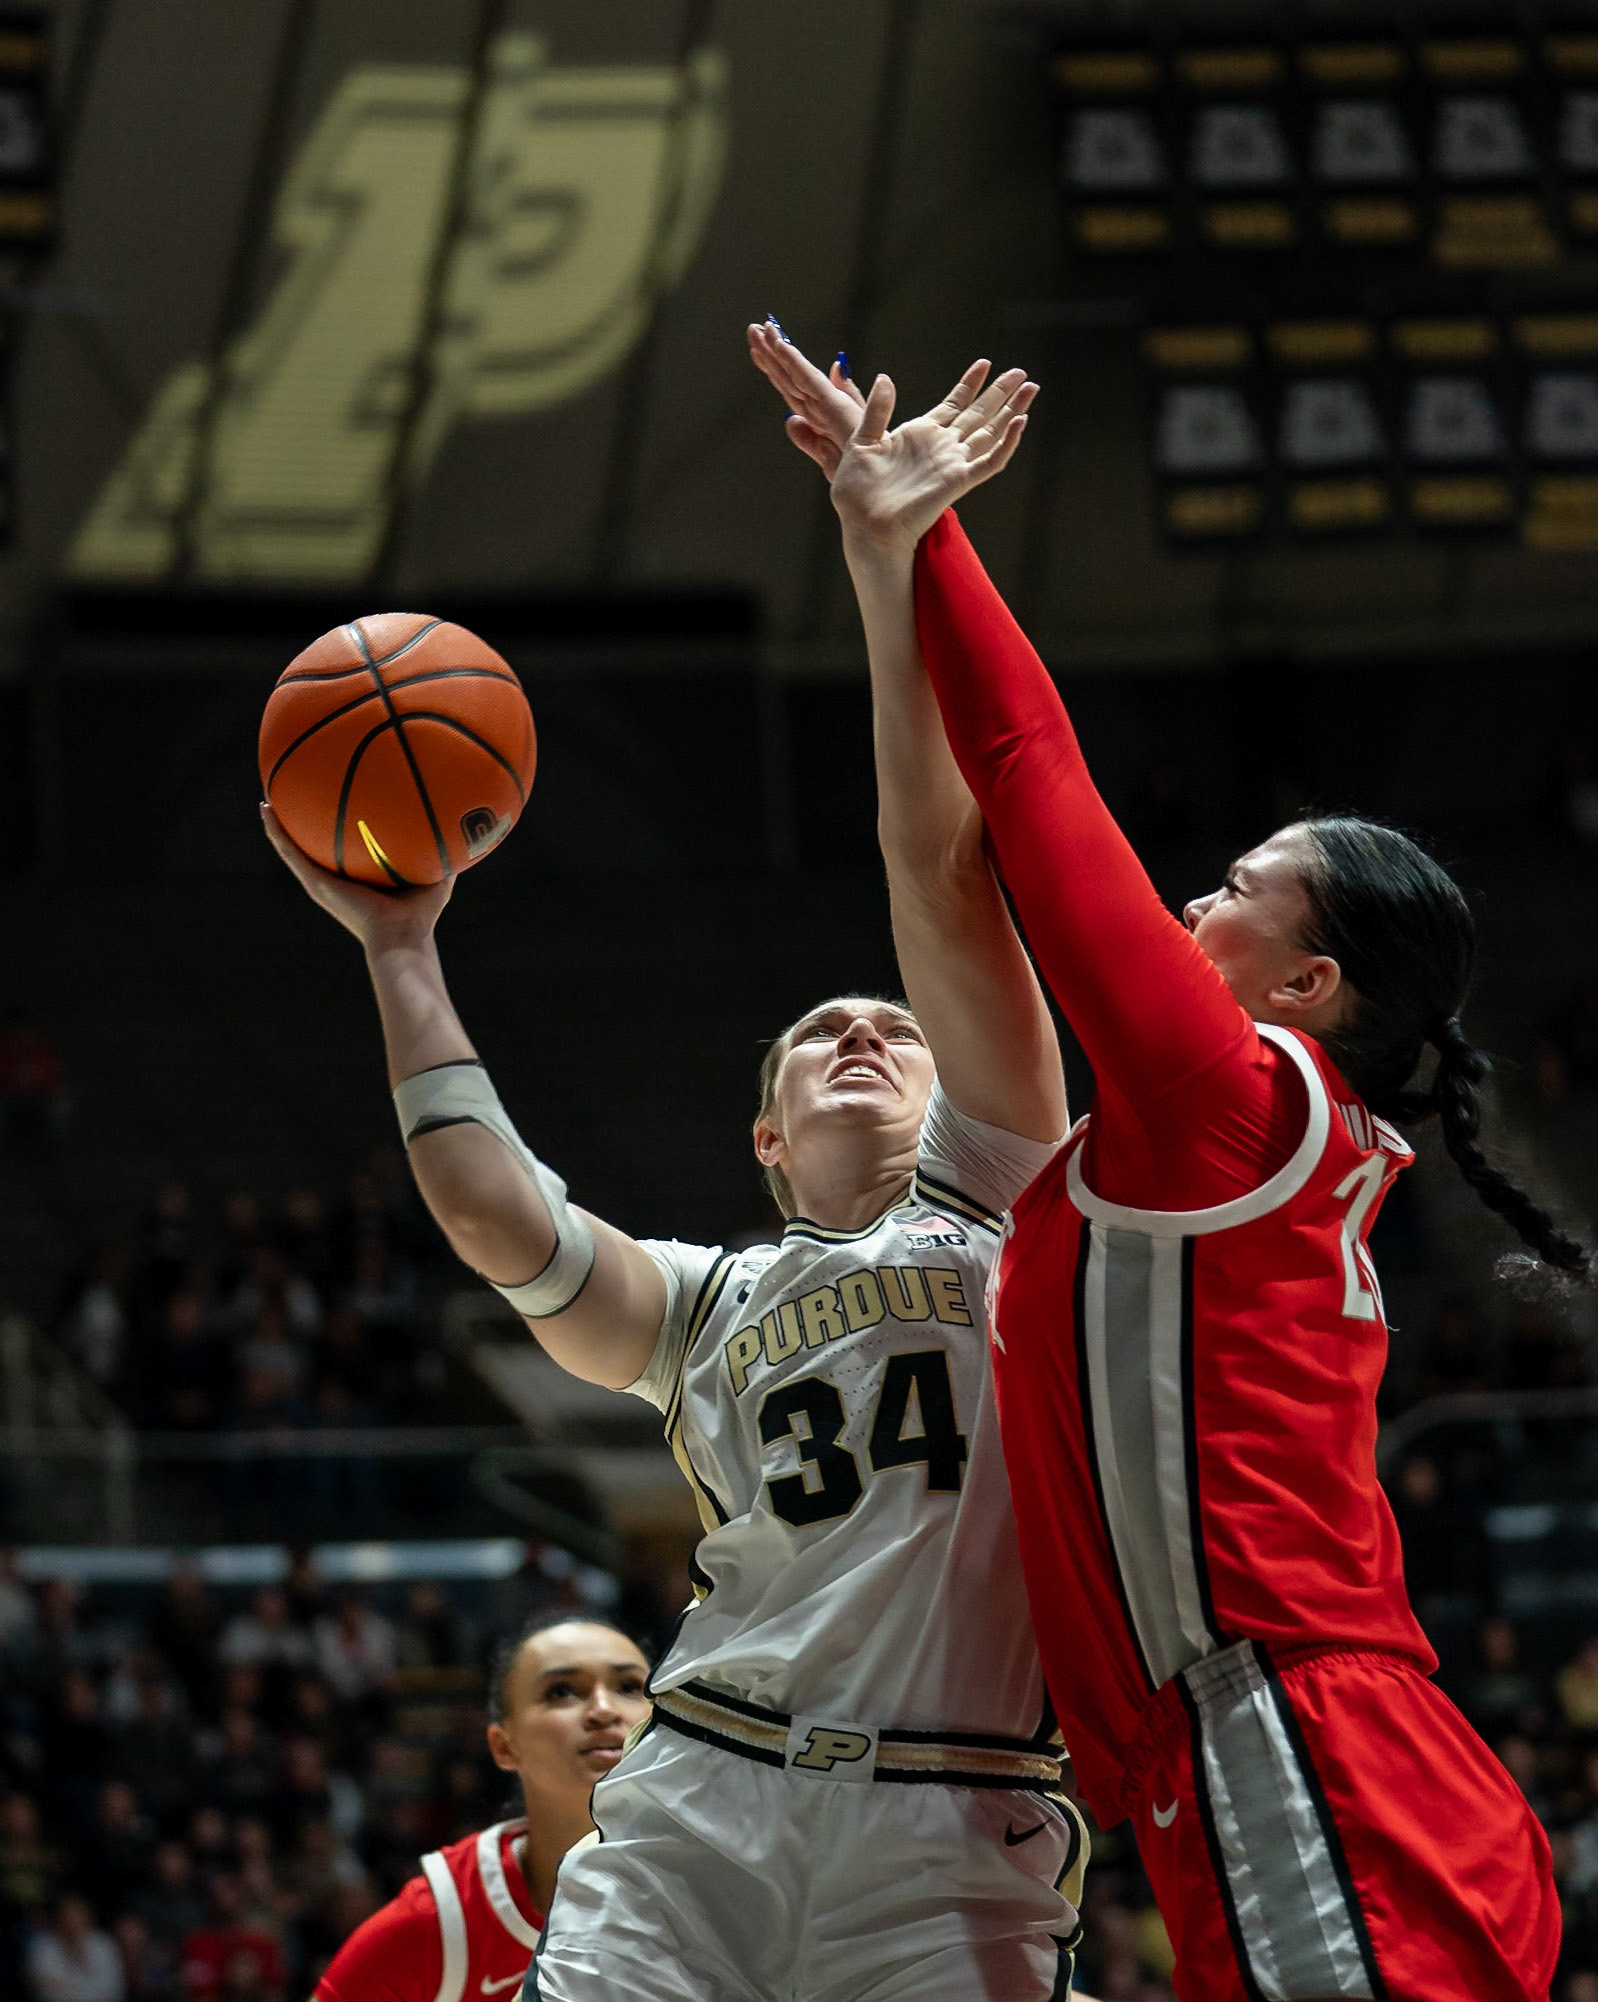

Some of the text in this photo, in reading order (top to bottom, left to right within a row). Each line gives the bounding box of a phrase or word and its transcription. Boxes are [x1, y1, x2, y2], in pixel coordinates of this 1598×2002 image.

[724, 1265, 974, 1397] PURDUE
[757, 1348, 968, 1528] 34
[791, 1726, 871, 1772] P
